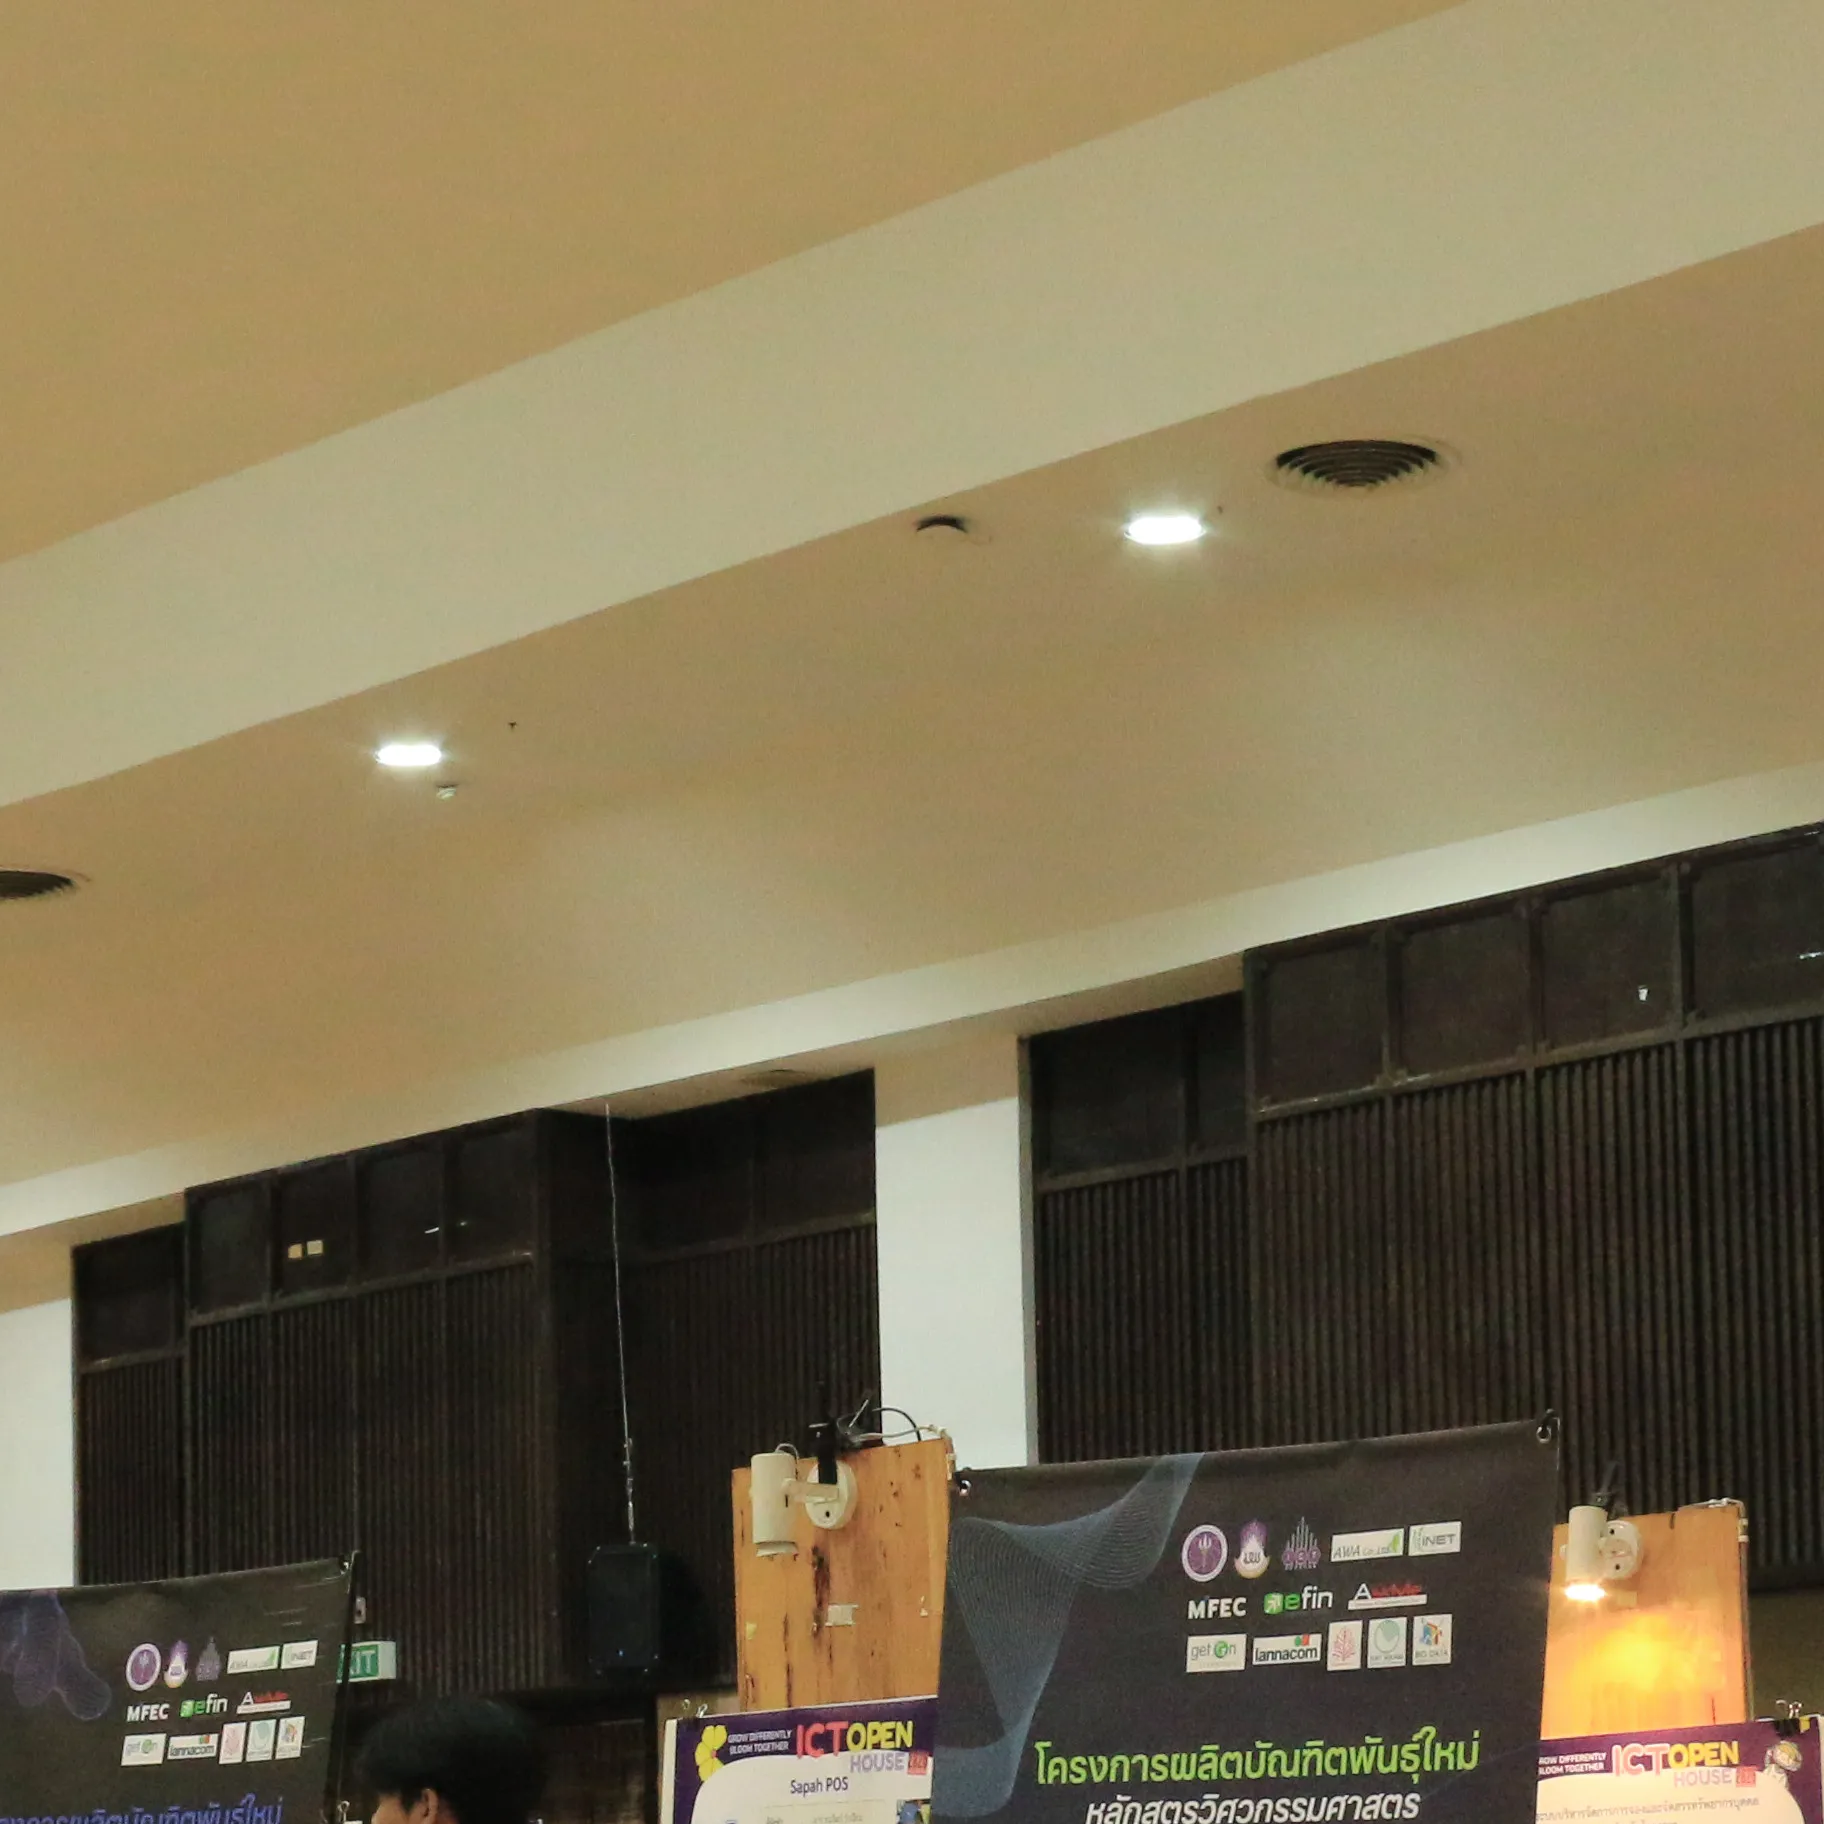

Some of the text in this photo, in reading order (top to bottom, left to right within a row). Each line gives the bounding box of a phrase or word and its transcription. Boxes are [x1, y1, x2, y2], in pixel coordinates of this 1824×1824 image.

[1422, 1533, 1456, 1546] INET
[1188, 1597, 1247, 1619] MFEC
[1284, 1585, 1333, 1610] efin
[1255, 1647, 1318, 1661] lannacom
[127, 1703, 170, 1722] MFEC
[796, 1720, 914, 1759] ICT OPEN
[850, 1753, 905, 1773] HOUSE
[1035, 1726, 1480, 1786] โครงการผลิตบัณฑิตพันธุ์ใหม่
[1611, 1741, 1740, 1777] ICT OPEN
[790, 1776, 849, 1798] Sapah POS
[1674, 1769, 1732, 1787] HOUSE
